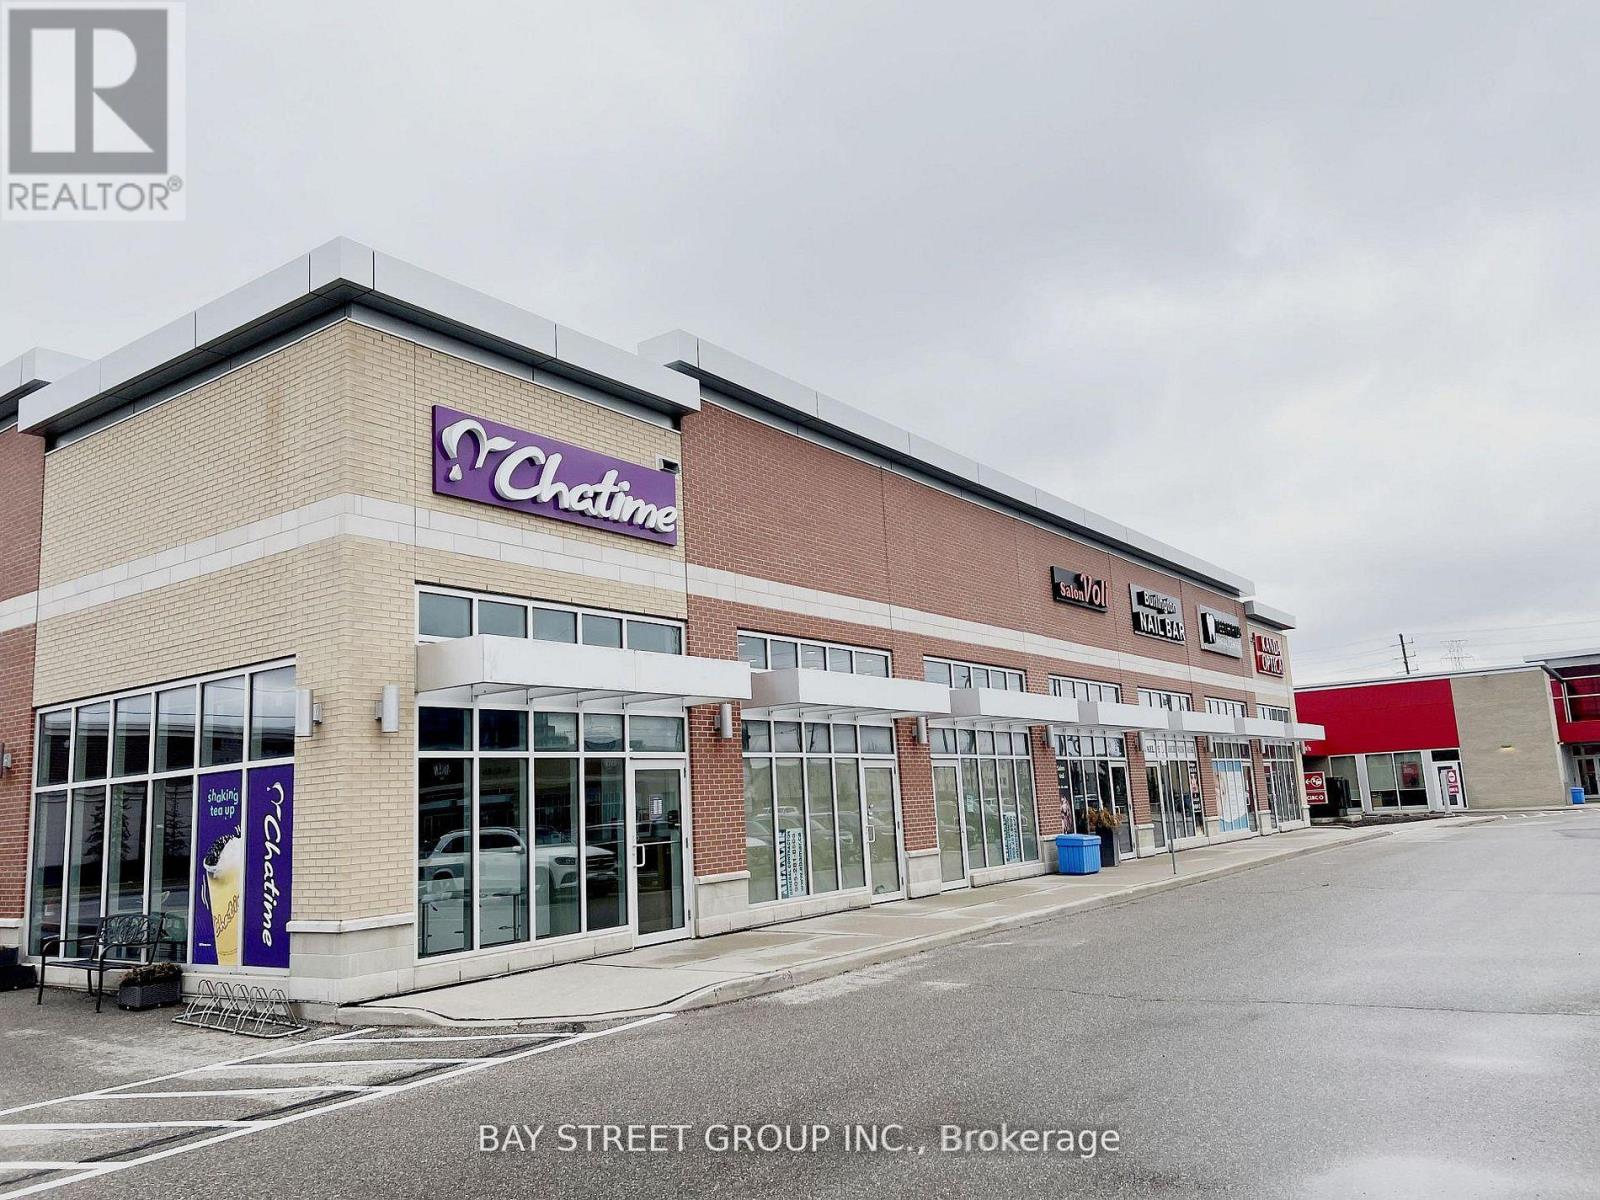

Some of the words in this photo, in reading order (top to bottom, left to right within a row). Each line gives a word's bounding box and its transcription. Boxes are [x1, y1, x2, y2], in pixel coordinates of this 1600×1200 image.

[494, 446, 677, 532] Chatime
[1060, 581, 1084, 602] Salon
[1140, 611, 1164, 635] NAIL
[1165, 618, 1186, 641] BAR
[207, 787, 239, 805] shaking
[210, 806, 223, 817] tea
[224, 806, 235, 818] up
[263, 814, 281, 947] Chatime
